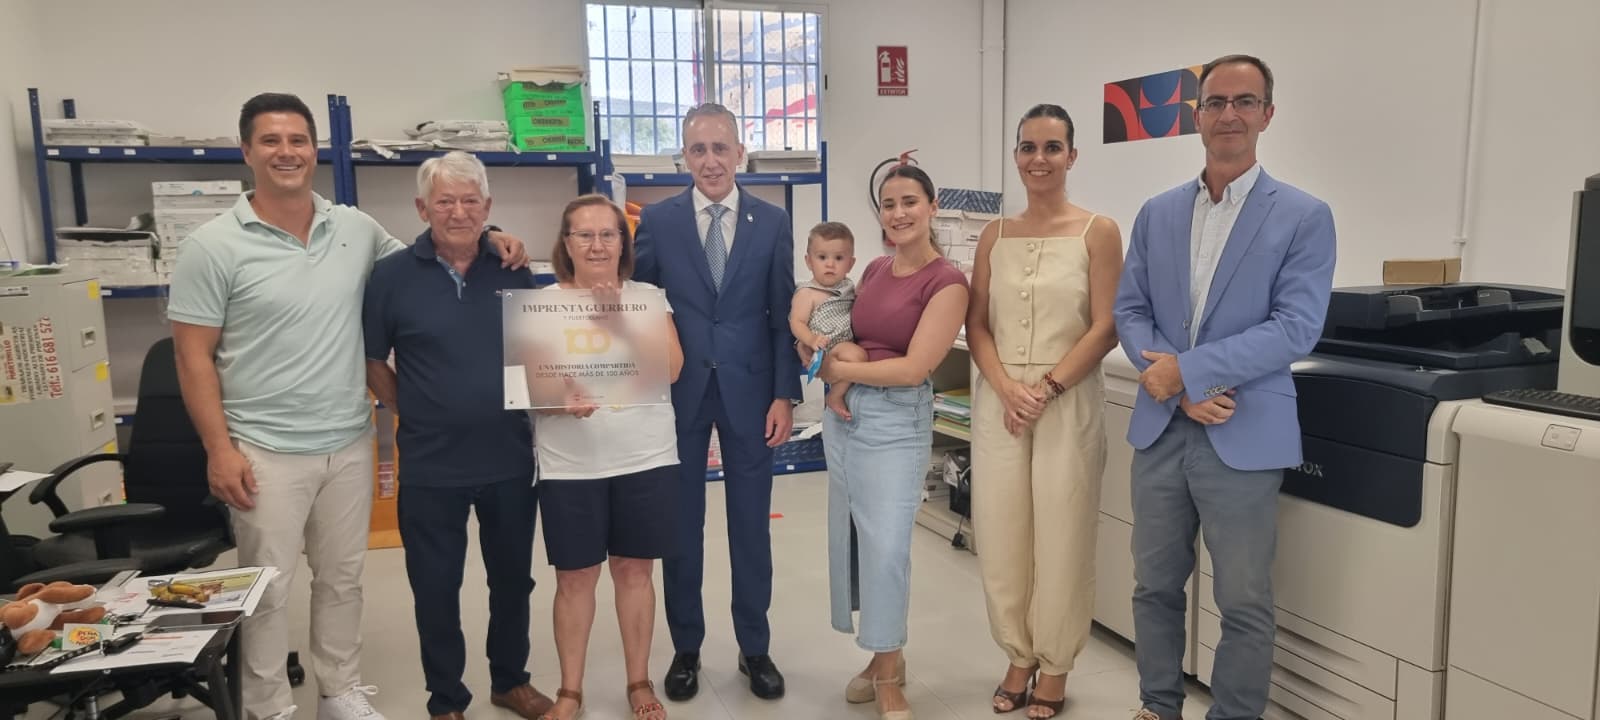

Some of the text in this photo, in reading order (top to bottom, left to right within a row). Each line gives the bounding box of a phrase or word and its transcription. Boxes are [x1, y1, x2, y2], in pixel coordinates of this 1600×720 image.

[522, 303, 647, 313] IMPRENTA GUERRERO
[41, 338, 55, 354] 681
[44, 356, 59, 373] 616
[538, 363, 553, 371] UNA
[590, 361, 636, 369] COMPARTIDA
[579, 369, 594, 377] MÁS
[619, 368, 639, 377] AÑOS
